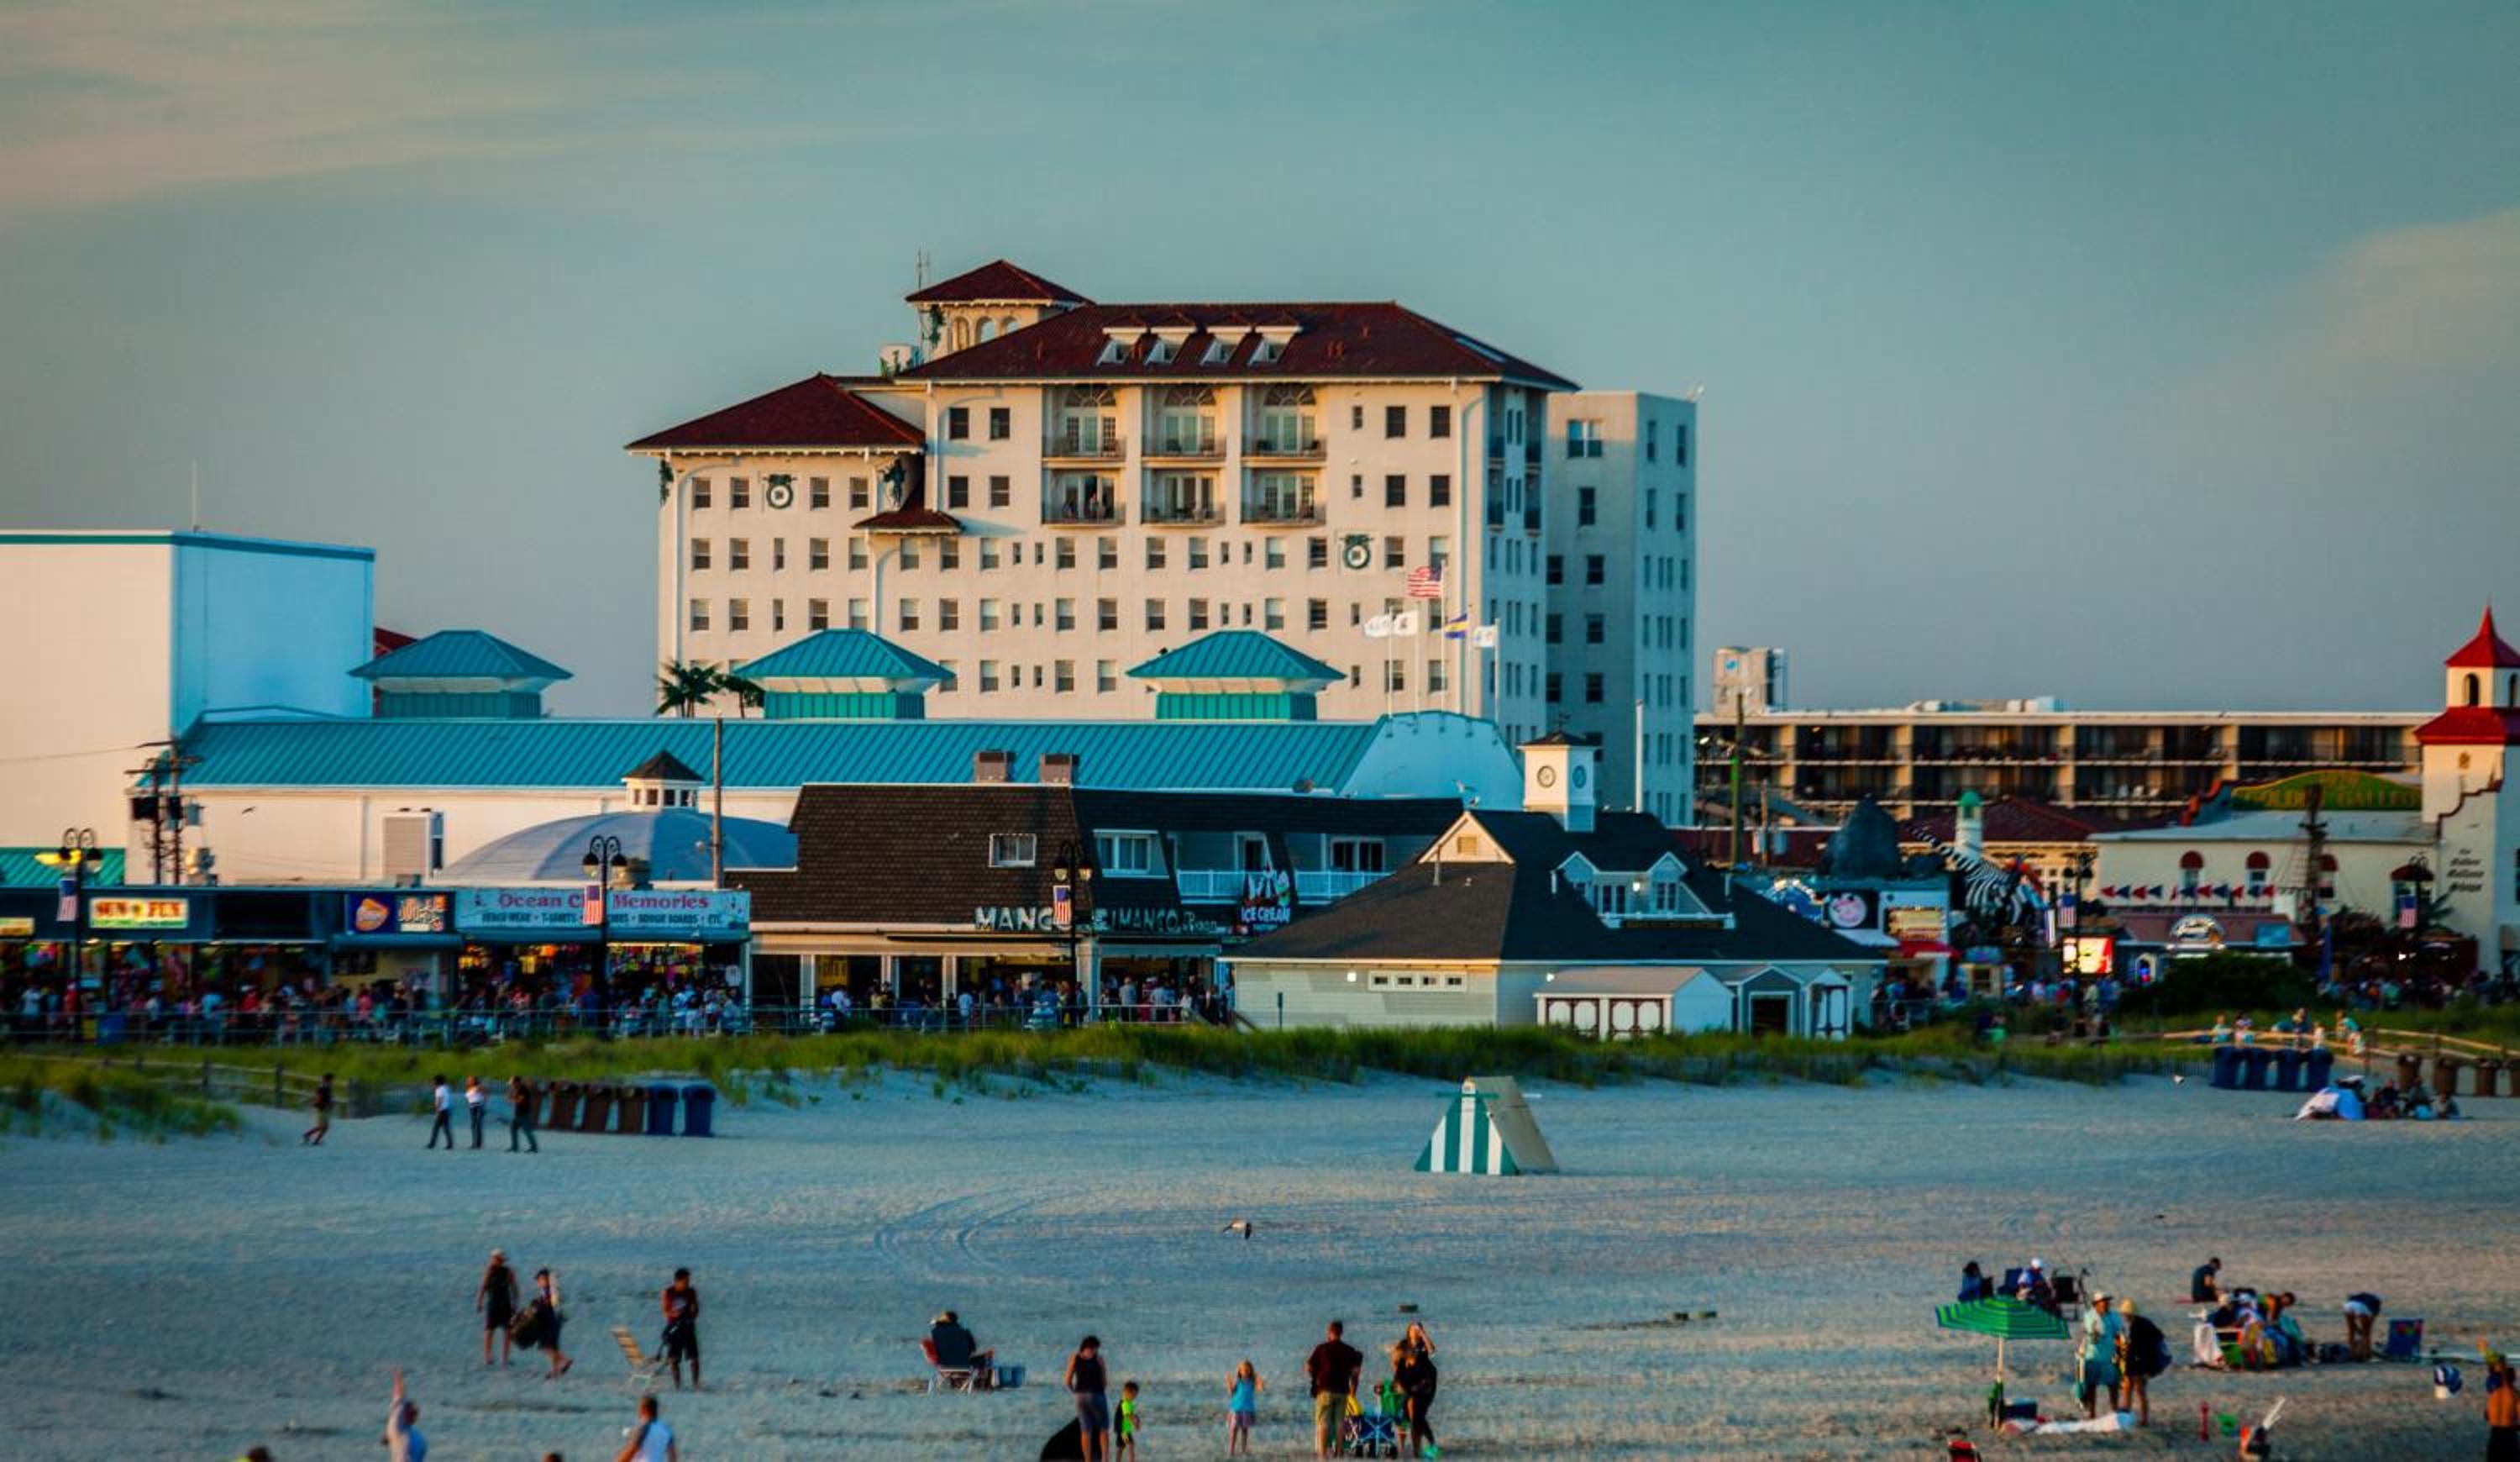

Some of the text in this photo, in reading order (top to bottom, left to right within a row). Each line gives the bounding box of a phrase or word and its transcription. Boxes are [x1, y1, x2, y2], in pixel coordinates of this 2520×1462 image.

[499, 893, 562, 908] Ocean
[612, 894, 709, 909] Memories
[1119, 907, 1180, 931] MANCO
[1241, 907, 1291, 923] ICE CREAM
